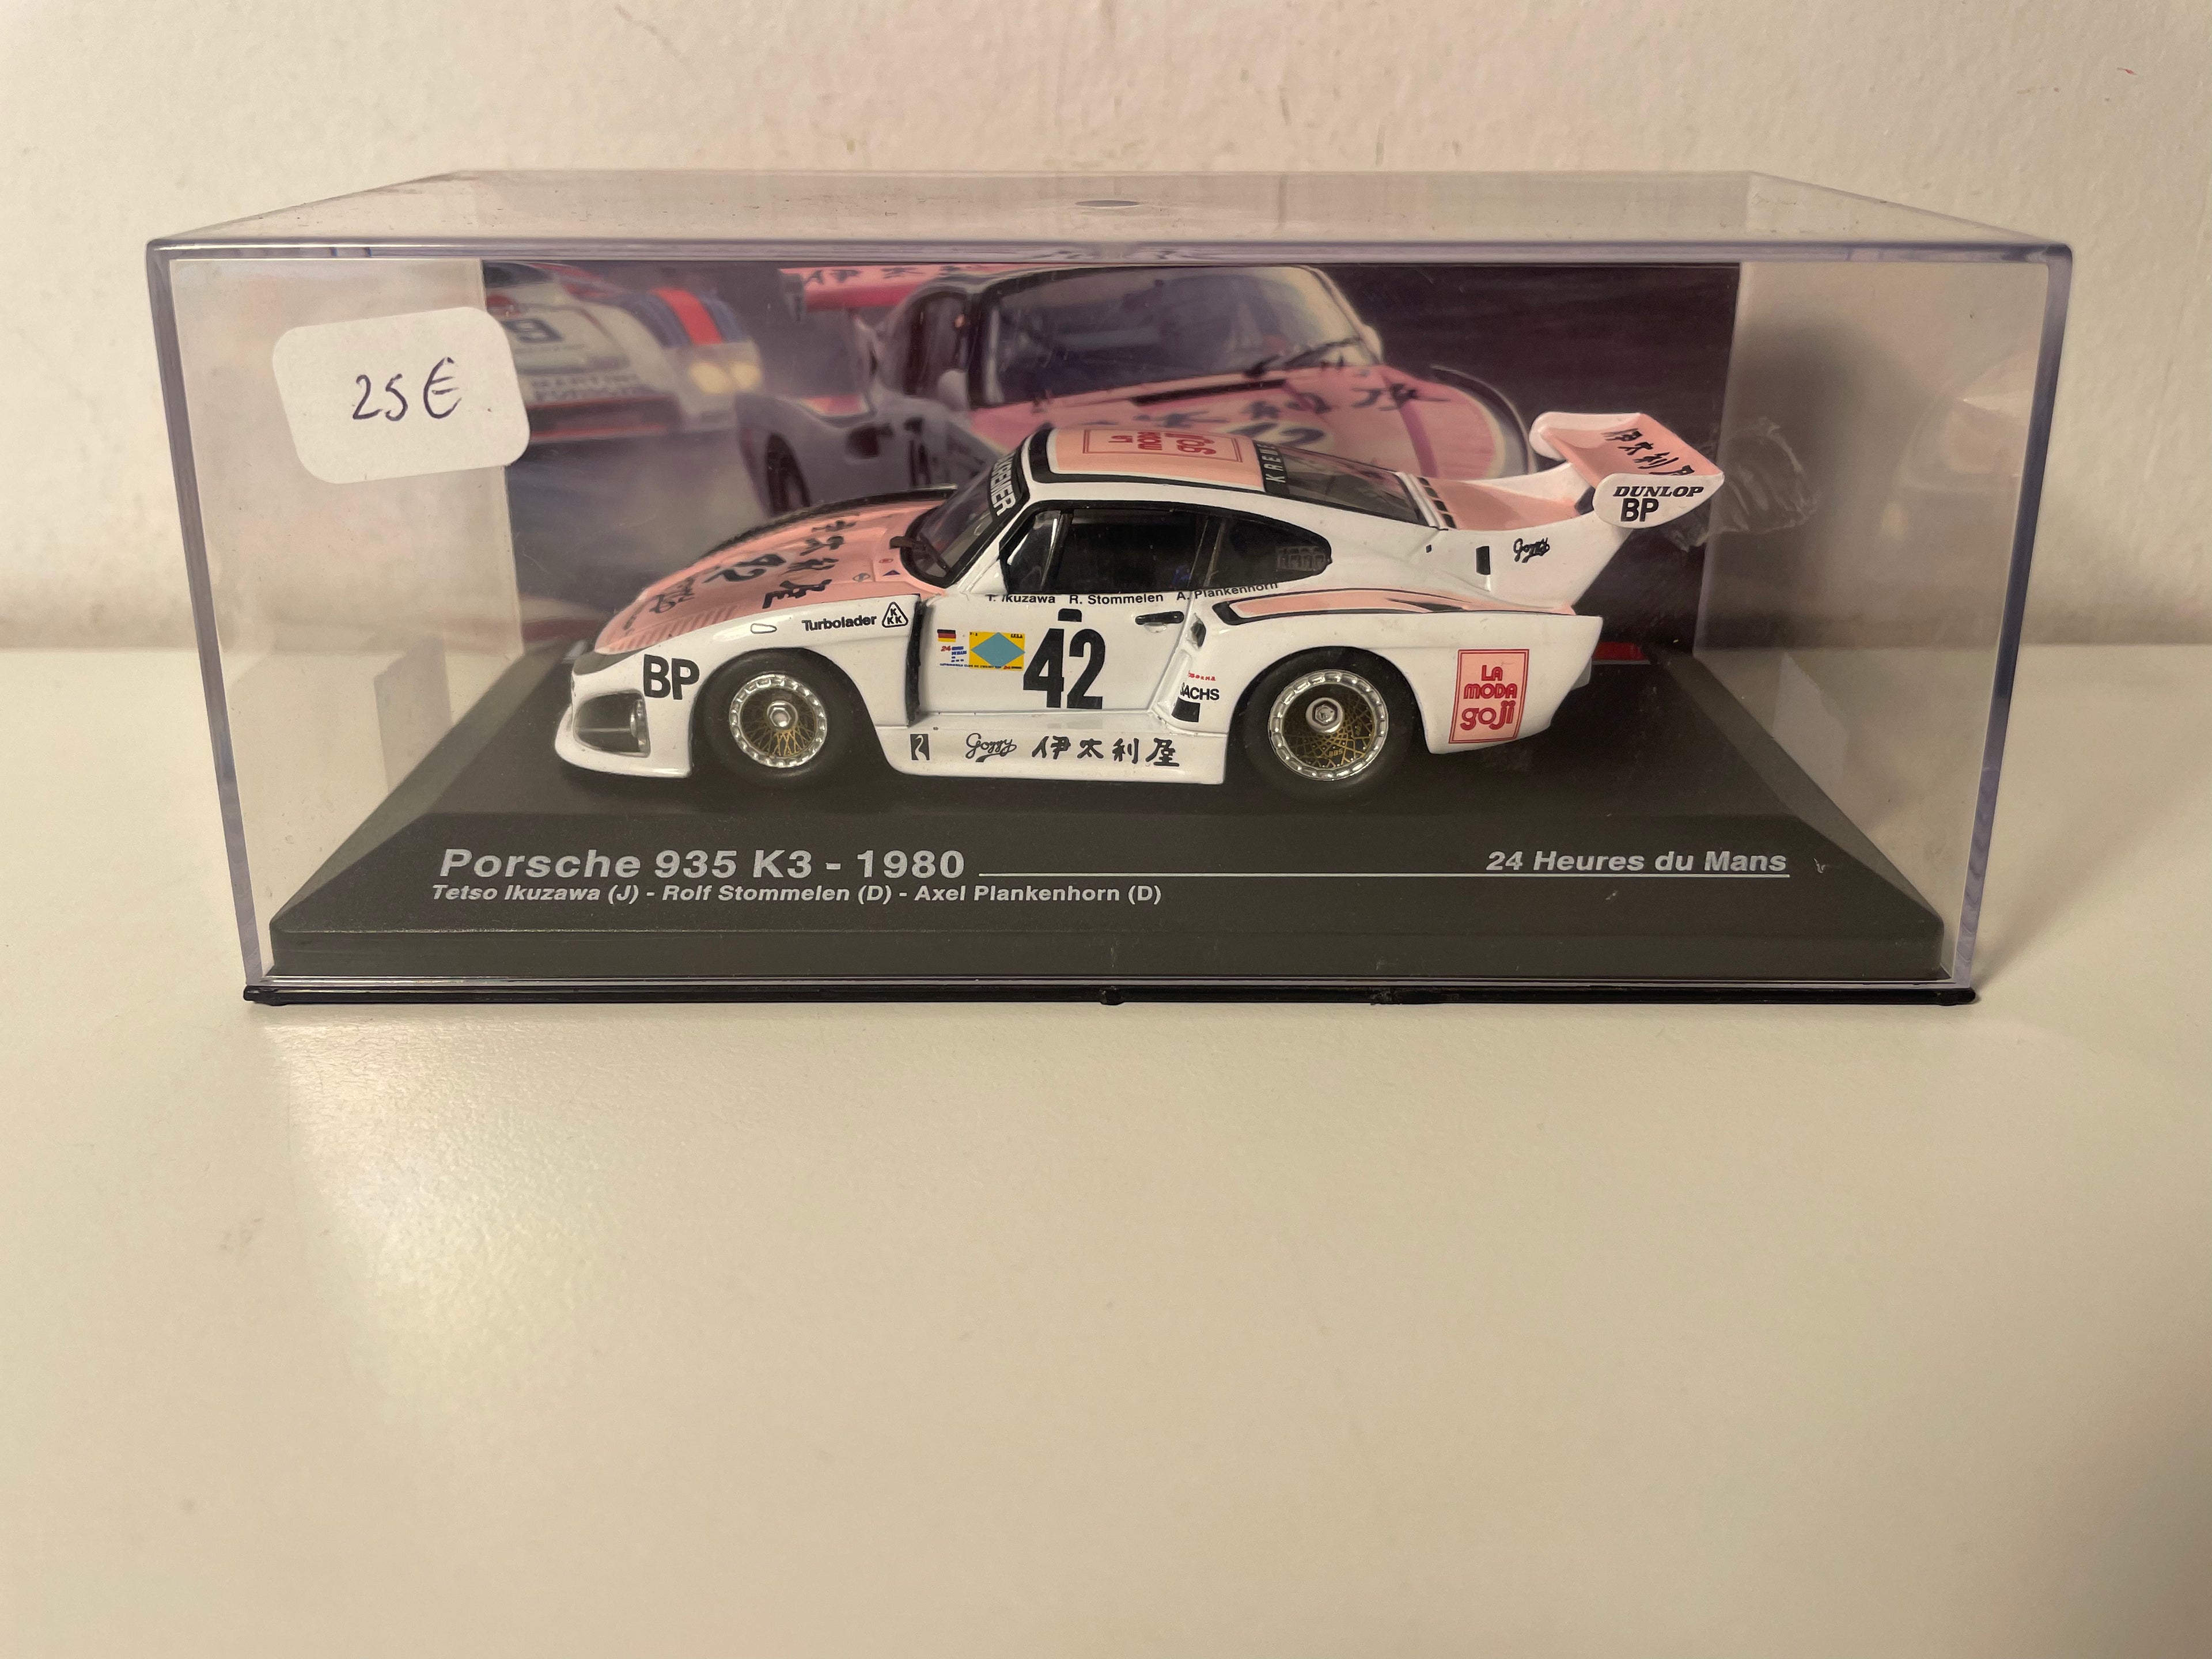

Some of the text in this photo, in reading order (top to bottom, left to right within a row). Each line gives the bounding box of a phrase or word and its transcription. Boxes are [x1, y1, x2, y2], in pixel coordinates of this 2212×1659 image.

[1613, 486, 1704, 497] DUNLOP
[1620, 498, 1660, 522] BP
[1069, 594, 1082, 604] R.
[1087, 593, 1164, 605] Stommelen
[1176, 591, 1190, 601] A.
[1194, 581, 1278, 600] Plankenhorn
[801, 615, 877, 631] Turbolader
[643, 654, 700, 700] BP
[1023, 628, 1105, 709] 42
[1481, 665, 1503, 681] LA
[1179, 681, 1219, 700] SACHS
[1463, 683, 1518, 699] MODA
[1460, 700, 1516, 730] goji
[1031, 735, 1180, 767] 伊太利屋
[440, 849, 641, 878] Porsche
[654, 850, 737, 878] 935
[753, 850, 812, 878] K3
[857, 850, 964, 878] 1980
[1486, 851, 1786, 872] 24 Heures du Mans
[432, 884, 498, 900] Tetso
[504, 884, 601, 901] Ikuzawa
[608, 884, 639, 905] (J)
[662, 885, 713, 901] Rolf
[718, 885, 850, 901] Stommelen
[858, 885, 892, 905] (D)
[914, 885, 966, 901] Axel
[974, 885, 1120, 901] Plankenhorn
[1128, 885, 1162, 905] (D)
